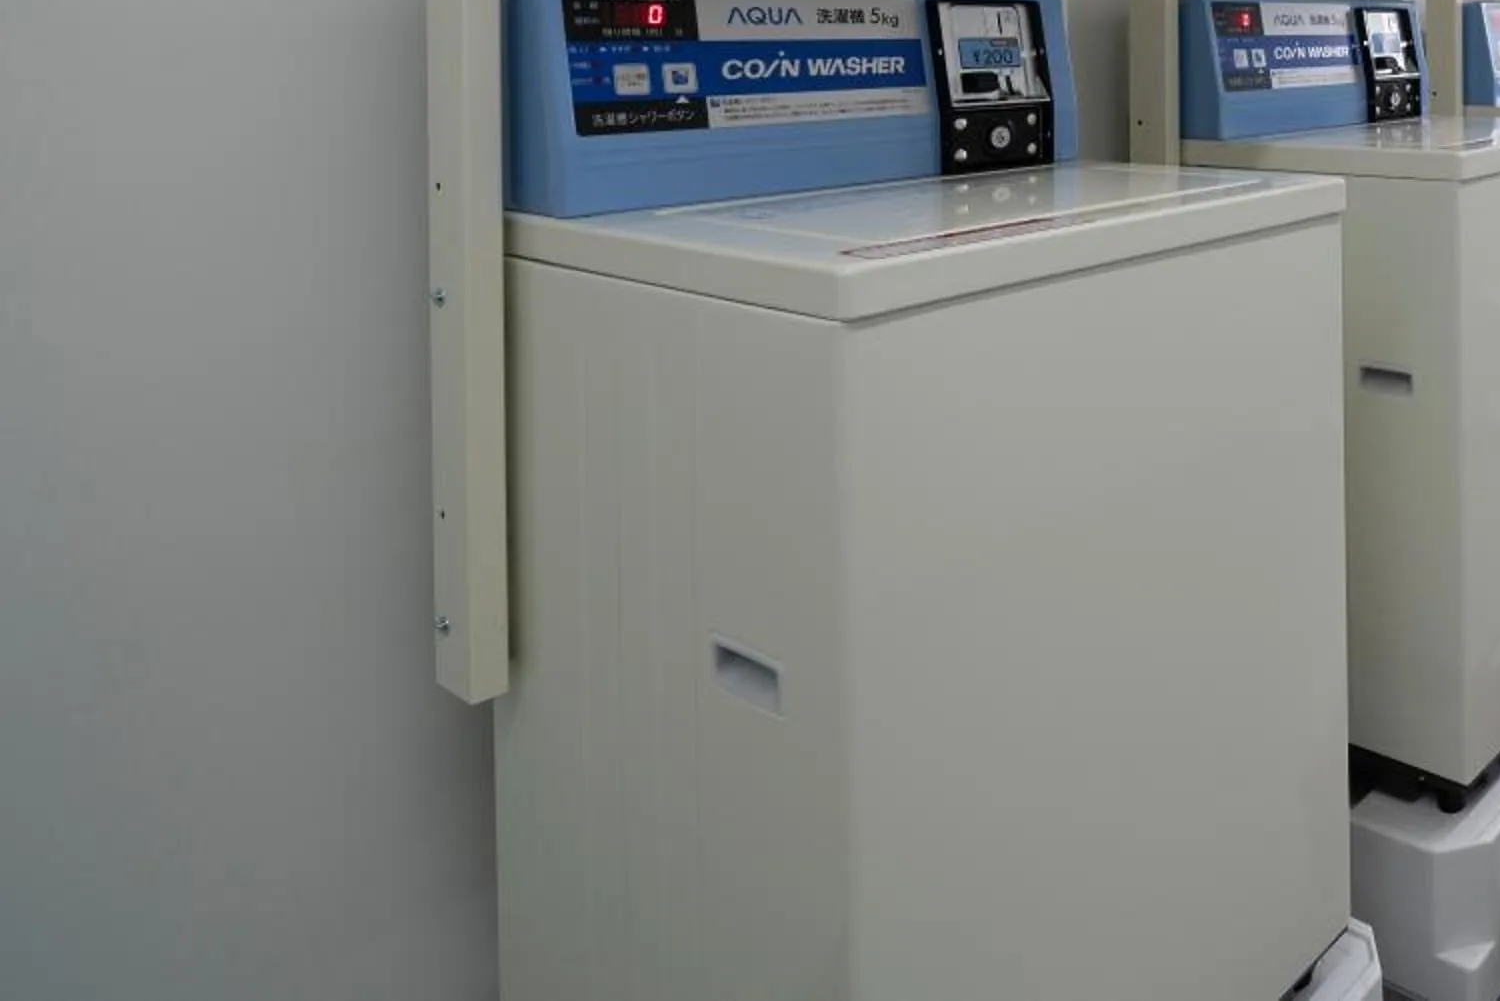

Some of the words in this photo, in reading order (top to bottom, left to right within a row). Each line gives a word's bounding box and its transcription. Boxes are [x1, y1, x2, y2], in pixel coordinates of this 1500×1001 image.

[648, 4, 663, 24] 0
[727, 6, 804, 26] AQUA
[869, 7, 900, 28] 5kg
[721, 50, 800, 80] COIN
[807, 55, 905, 77] WASHER
